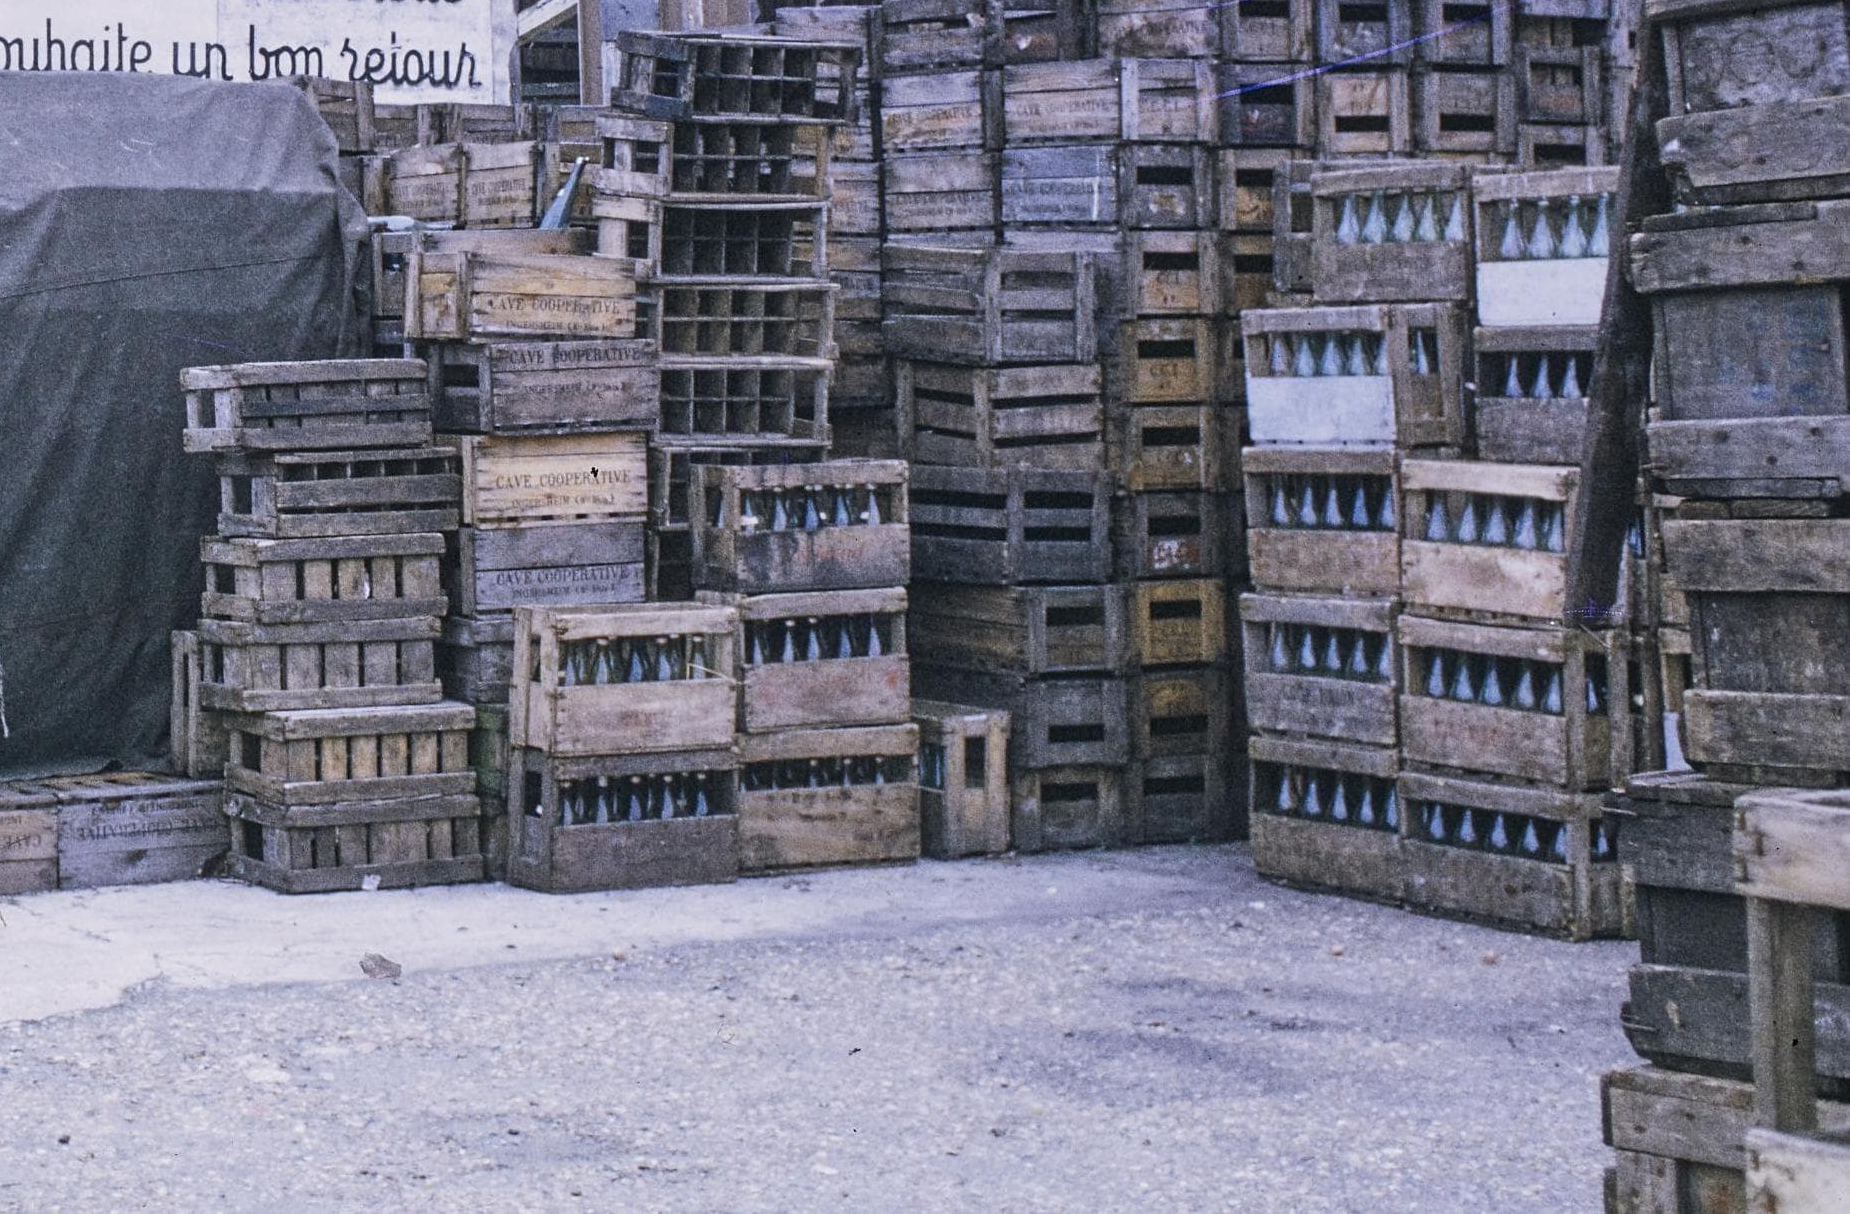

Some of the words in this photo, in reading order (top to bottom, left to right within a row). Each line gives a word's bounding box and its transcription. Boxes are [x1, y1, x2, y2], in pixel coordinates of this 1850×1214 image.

[172, 41, 234, 81] un
[248, 24, 325, 82] bon
[340, 31, 483, 88] retour
[510, 349, 545, 366] CAVE
[496, 474, 533, 489] CAVE
[540, 469, 631, 488] COOPERATIVE
[496, 571, 533, 586] CAVE
[538, 564, 630, 584] COOPERATIVE
[3, 834, 43, 850] CAVE
